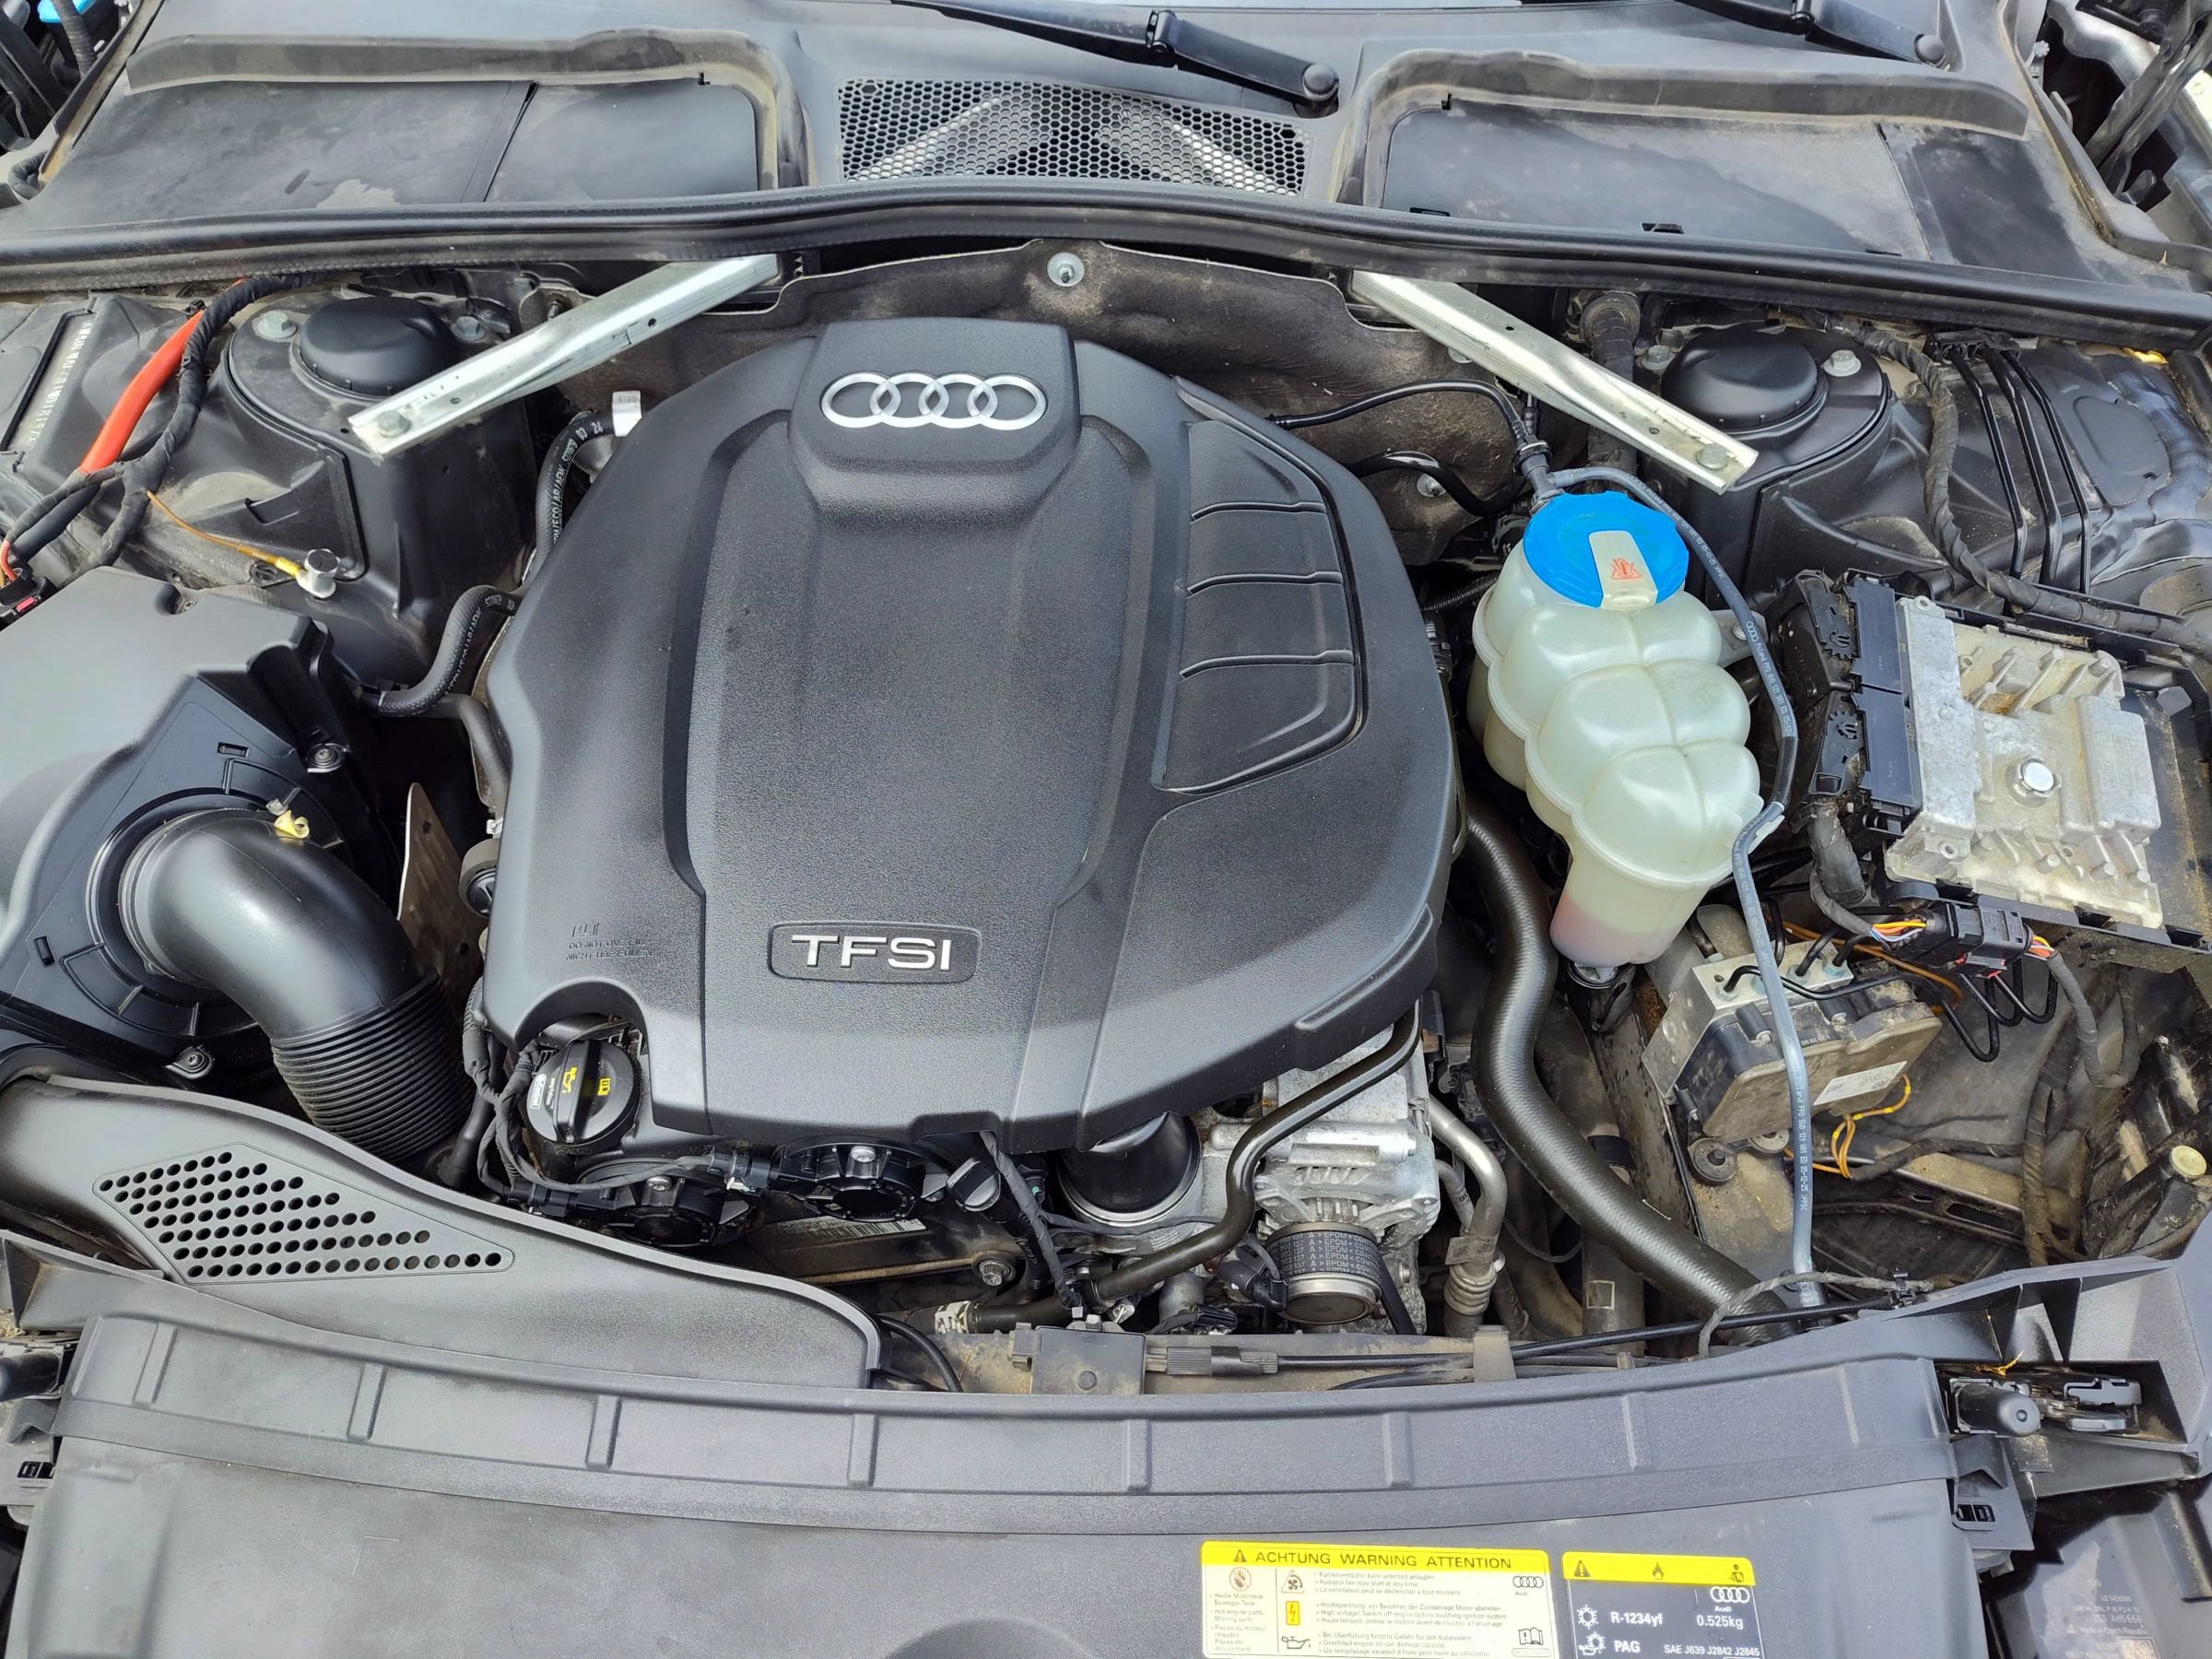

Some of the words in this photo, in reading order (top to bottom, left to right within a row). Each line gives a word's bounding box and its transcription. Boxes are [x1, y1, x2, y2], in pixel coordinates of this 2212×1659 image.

[1755, 642, 1768, 664] Poland
[1762, 662, 1771, 673] PPO
[566, 952, 594, 960] NICHT
[791, 934, 951, 971] TFSI
[1796, 1077, 1805, 1103] Poland
[1255, 1551, 1331, 1565] ACHTUNG
[1340, 1554, 1418, 1567] WARNING
[1426, 1556, 1512, 1569] ATTENTION
[1611, 1612, 1664, 1627] R-1234yf
[1697, 1615, 1744, 1630] 0.525kg
[1614, 1641, 1641, 1653] PAG
[1665, 1644, 1682, 1653] SAE
[1685, 1645, 1705, 1654] J639
[1707, 1646, 1733, 1655] J2842
[1735, 1647, 1760, 1657] J2845
